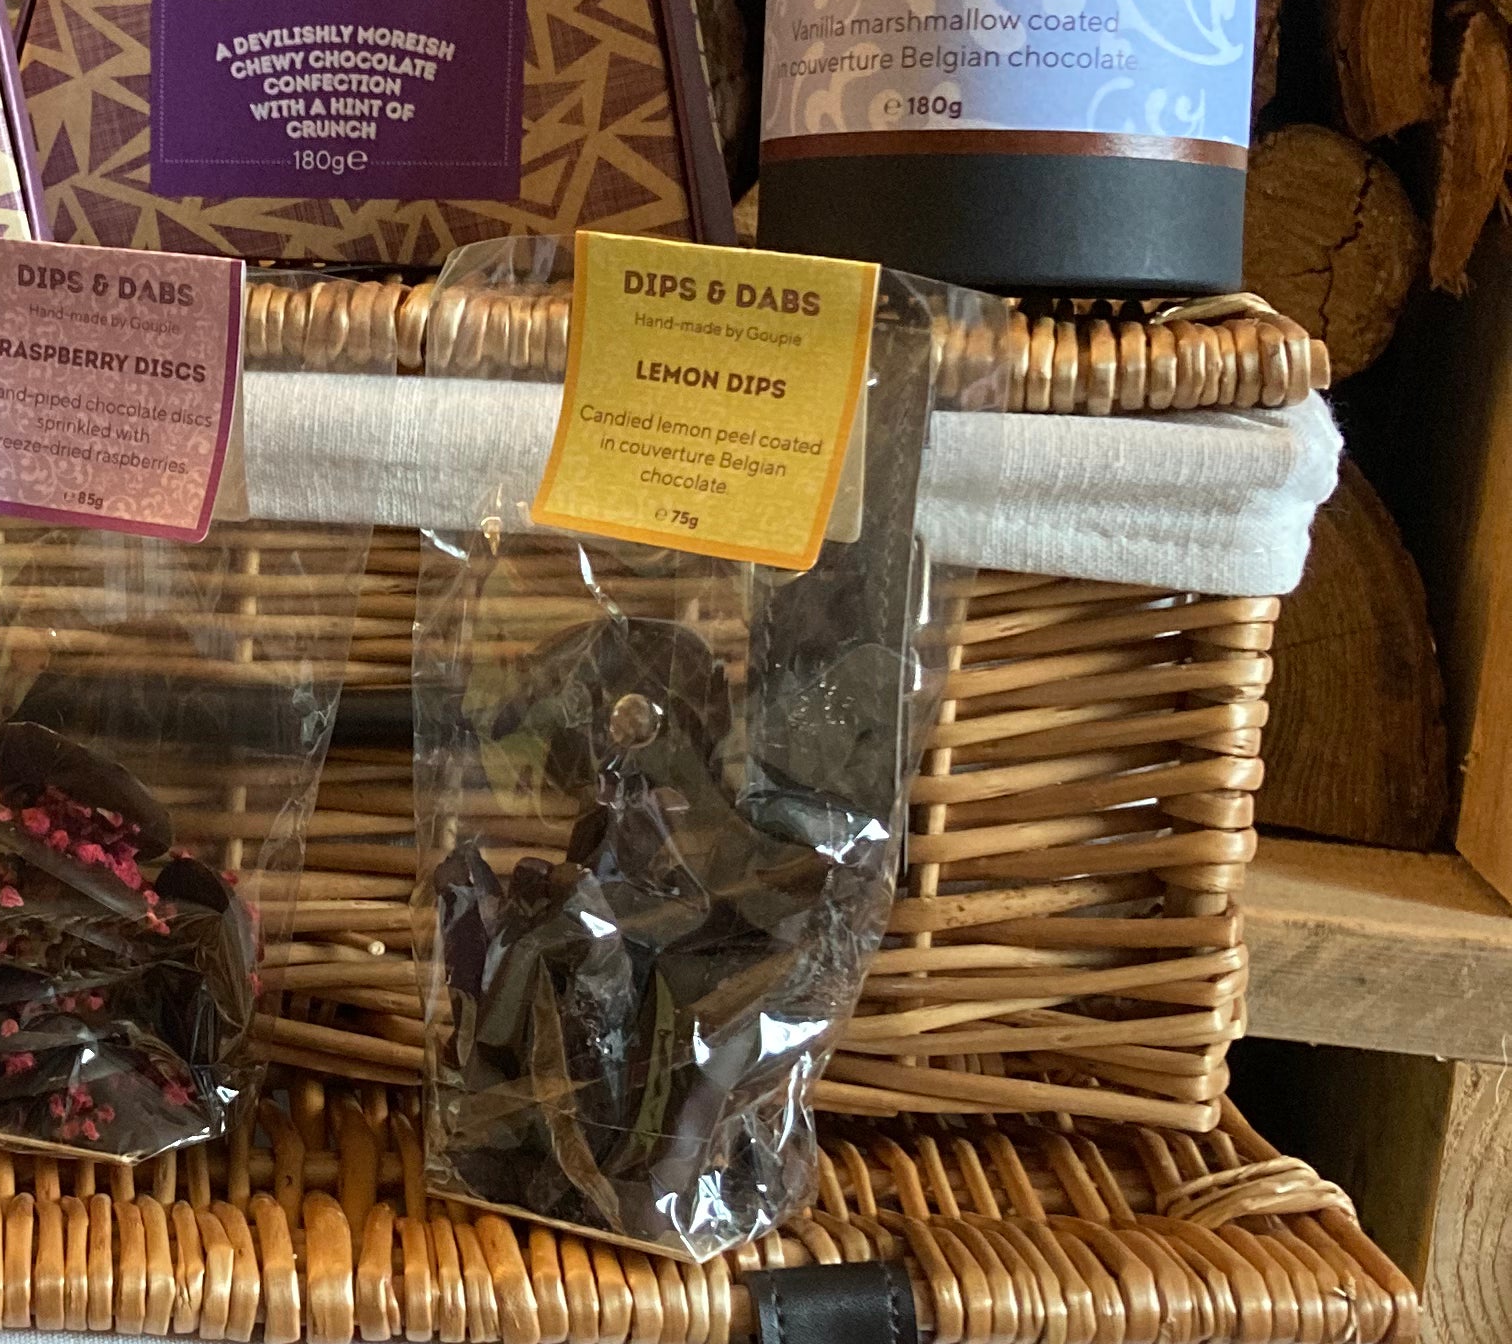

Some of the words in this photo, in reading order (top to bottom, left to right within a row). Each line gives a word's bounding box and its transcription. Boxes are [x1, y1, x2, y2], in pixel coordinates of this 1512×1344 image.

[792, 18, 844, 41] Vanilla
[850, 7, 1020, 36] marshmallow
[1028, 10, 1120, 32] coated
[216, 41, 232, 61] A
[234, 26, 354, 55] DEVILISHLY
[358, 26, 456, 60] MOREISH
[230, 52, 304, 79] CHEWY
[309, 50, 437, 81] CHOCOLATE
[790, 50, 893, 77] couverture
[901, 46, 1000, 73] Belgian
[263, 74, 403, 96] CONFECTION
[250, 100, 306, 121] WITH
[311, 100, 327, 116] A
[331, 98, 382, 119] HINT
[385, 101, 416, 122] OF
[908, 95, 962, 118] 180g
[286, 120, 376, 139] CRUNCH
[18, 264, 84, 293] DIPS
[92, 274, 109, 296] &
[119, 276, 194, 306] DABS
[624, 270, 697, 302] DIPS
[707, 280, 726, 304] &
[736, 283, 821, 317] DABS
[30, 304, 108, 326] Hand-made
[111, 314, 127, 330] by
[130, 316, 180, 335] Goupie
[635, 312, 721, 337] Hand-made
[726, 324, 744, 340] by
[746, 326, 802, 347] Goupie
[135, 356, 206, 383] DISCS
[637, 359, 719, 391] LEMON
[726, 373, 786, 399] DIPS
[86, 396, 166, 422] chocolate
[171, 409, 213, 427] discs
[37, 415, 112, 438] sprinkled
[116, 424, 150, 443] with
[580, 404, 653, 431] Candied
[657, 417, 711, 440] lemon
[716, 425, 755, 446] peel
[759, 432, 824, 456] coated
[600, 434, 616, 450] in
[619, 437, 716, 466] couverture
[720, 451, 786, 478] Belgian
[78, 490, 104, 509] 85g
[671, 509, 699, 529] 75g
